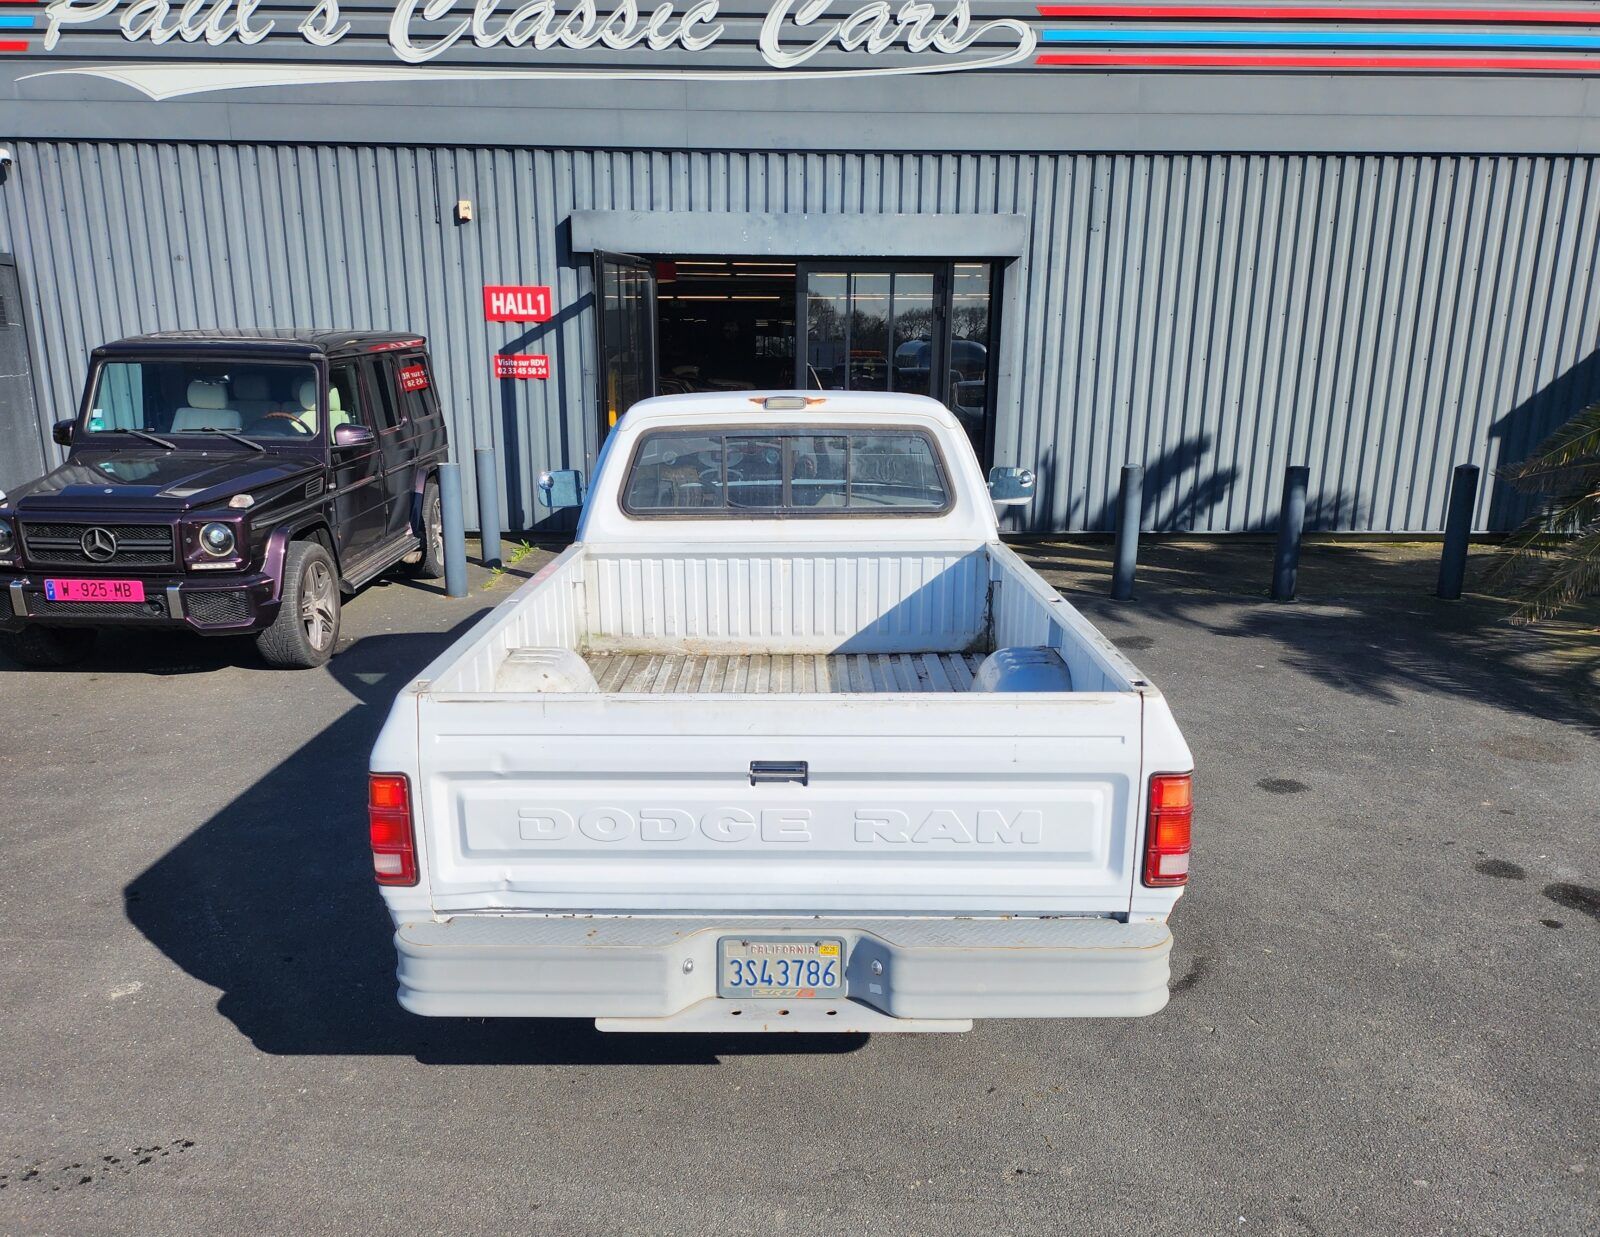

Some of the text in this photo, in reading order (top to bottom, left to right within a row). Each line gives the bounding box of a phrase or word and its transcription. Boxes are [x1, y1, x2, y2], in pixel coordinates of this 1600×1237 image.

[758, 0, 1037, 68] Cars
[497, 359, 518, 367] Visite
[530, 359, 546, 367] RDV
[497, 367, 507, 375] 02
[508, 367, 517, 375] 33
[517, 367, 527, 375] 45
[517, 807, 1043, 845] DODGE RAM
[750, 944, 816, 954] CALIFORNIA
[730, 959, 836, 987] 3S43786
